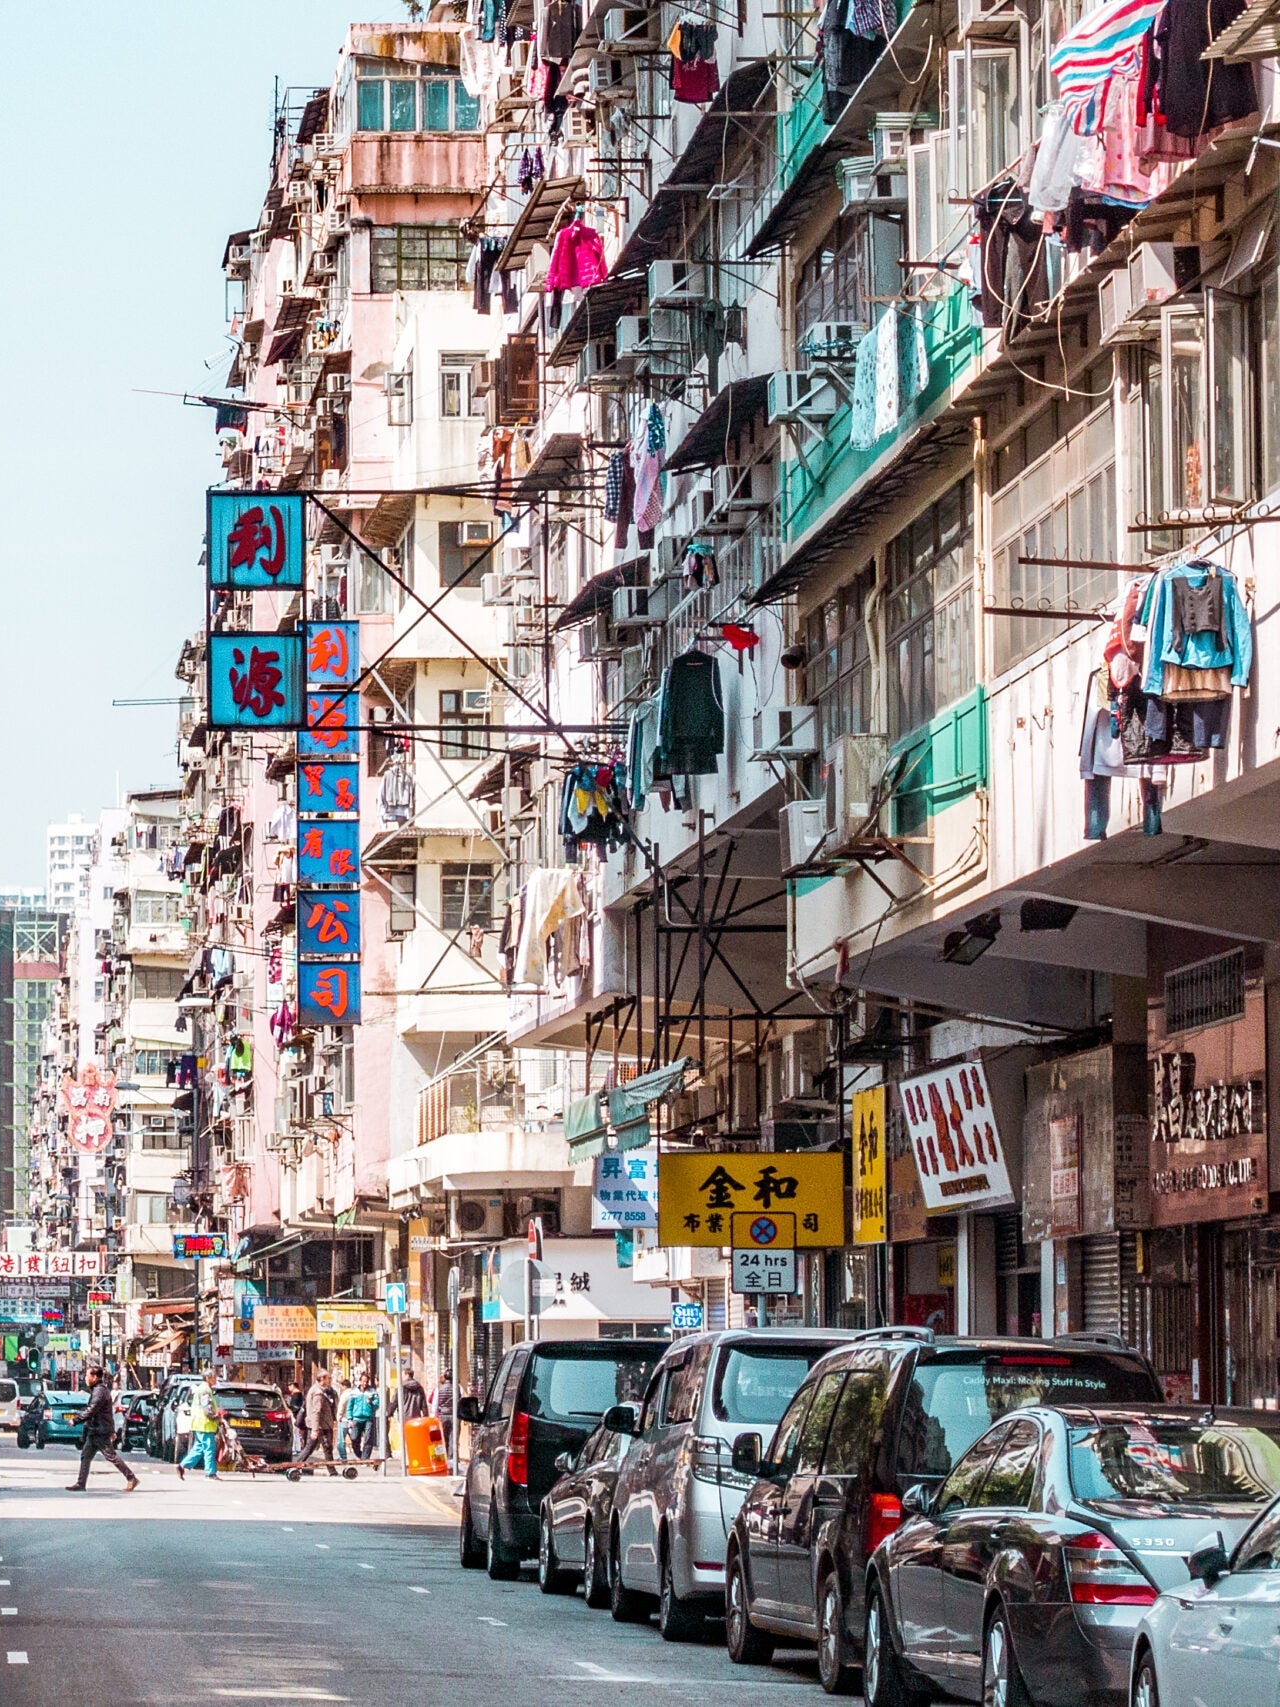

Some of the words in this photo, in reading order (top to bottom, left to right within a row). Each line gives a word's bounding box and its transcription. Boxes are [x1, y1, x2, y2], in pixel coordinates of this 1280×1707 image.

[601, 1157, 658, 1179] 昇富
[698, 1165, 799, 1209] 金和
[601, 1211, 622, 1221] 2777
[624, 1211, 646, 1221] 8558
[740, 1254, 760, 1267] 24
[765, 1254, 788, 1267] hrs
[745, 1271, 782, 1288] 全日
[675, 1306, 699, 1317] Sun
[320, 1320, 334, 1330] City
[674, 1316, 699, 1327] City
[321, 1338, 328, 1346] LI
[331, 1338, 351, 1346] FUNG
[354, 1337, 374, 1346] HONG
[963, 1375, 990, 1386] Caddy
[992, 1376, 1016, 1386] Maxi:
[1018, 1375, 1050, 1387] Moving
[1052, 1376, 1073, 1387] Stuff
[1075, 1377, 1083, 1387] in
[1084, 1379, 1106, 1390] Style
